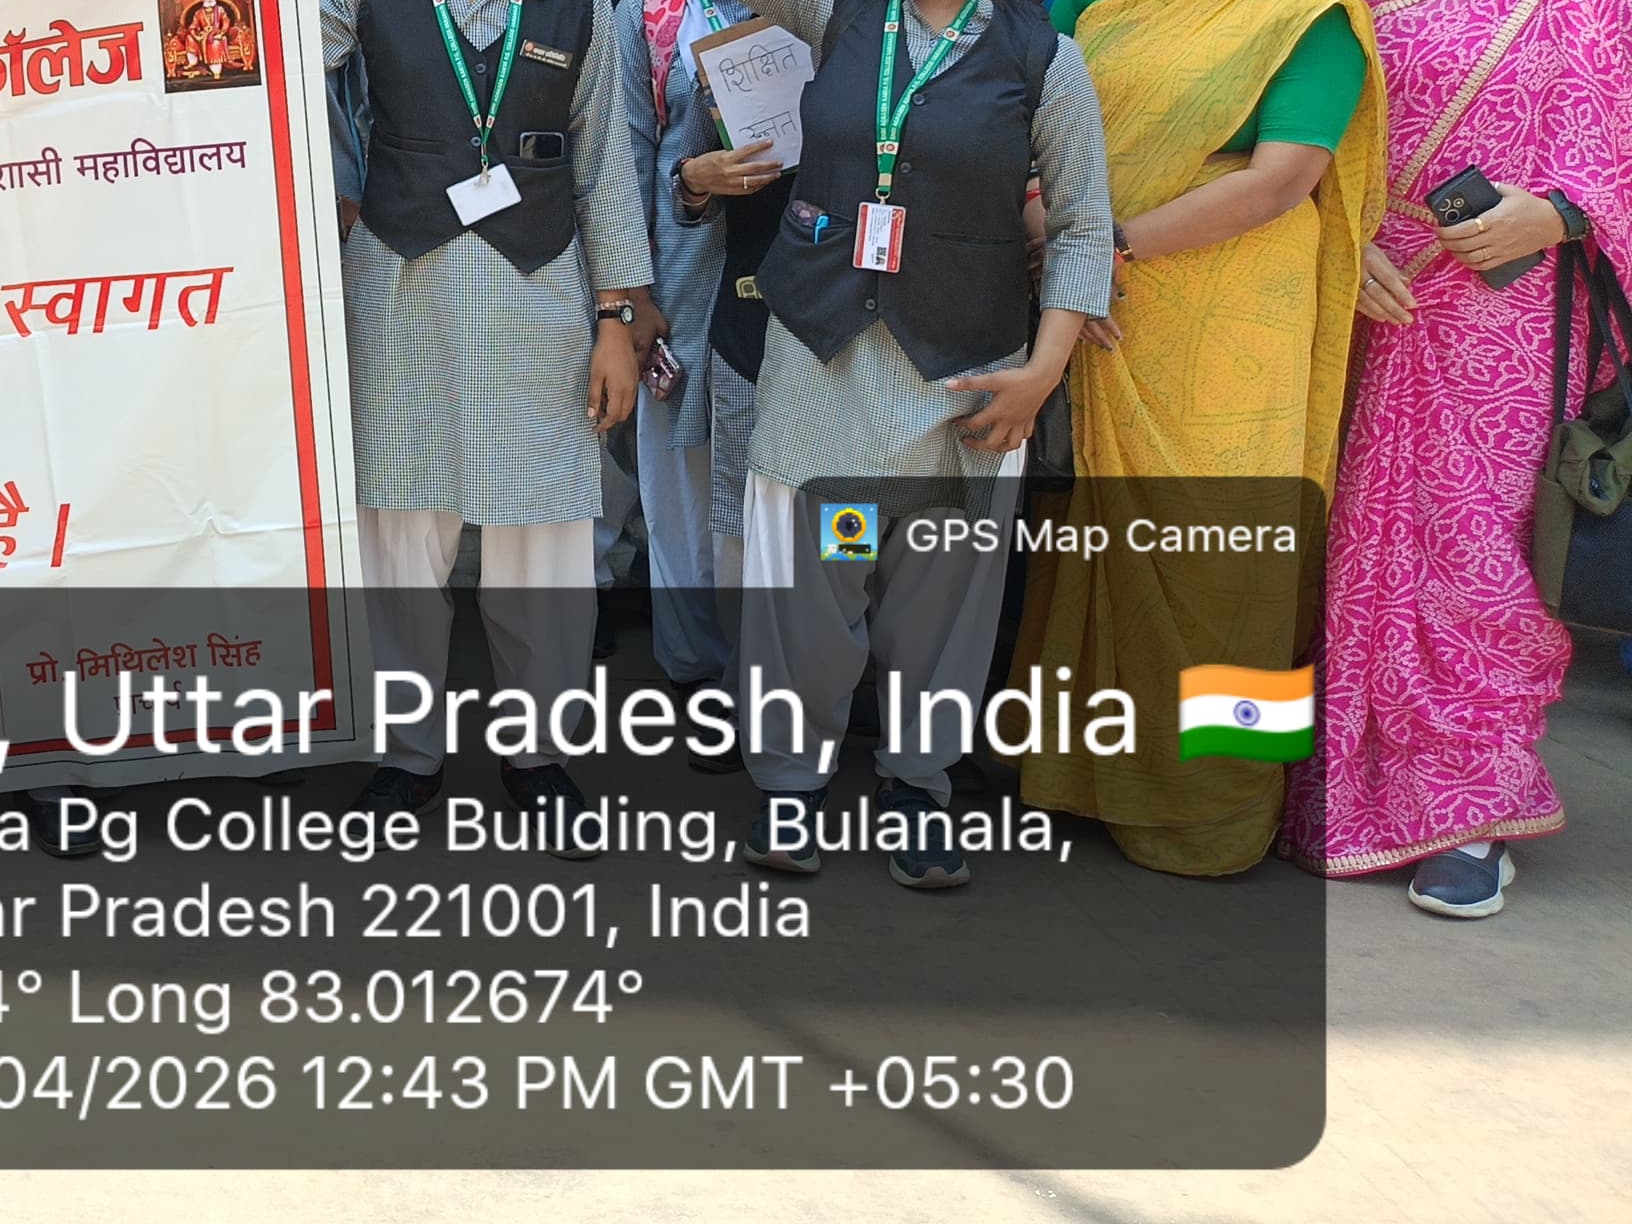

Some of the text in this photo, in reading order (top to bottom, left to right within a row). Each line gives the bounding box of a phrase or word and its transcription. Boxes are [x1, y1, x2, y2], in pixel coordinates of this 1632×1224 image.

[74, 137, 247, 184] महाविद्यालय
[1, 266, 235, 339] स्वागत
[206, 635, 263, 667] सिंह
